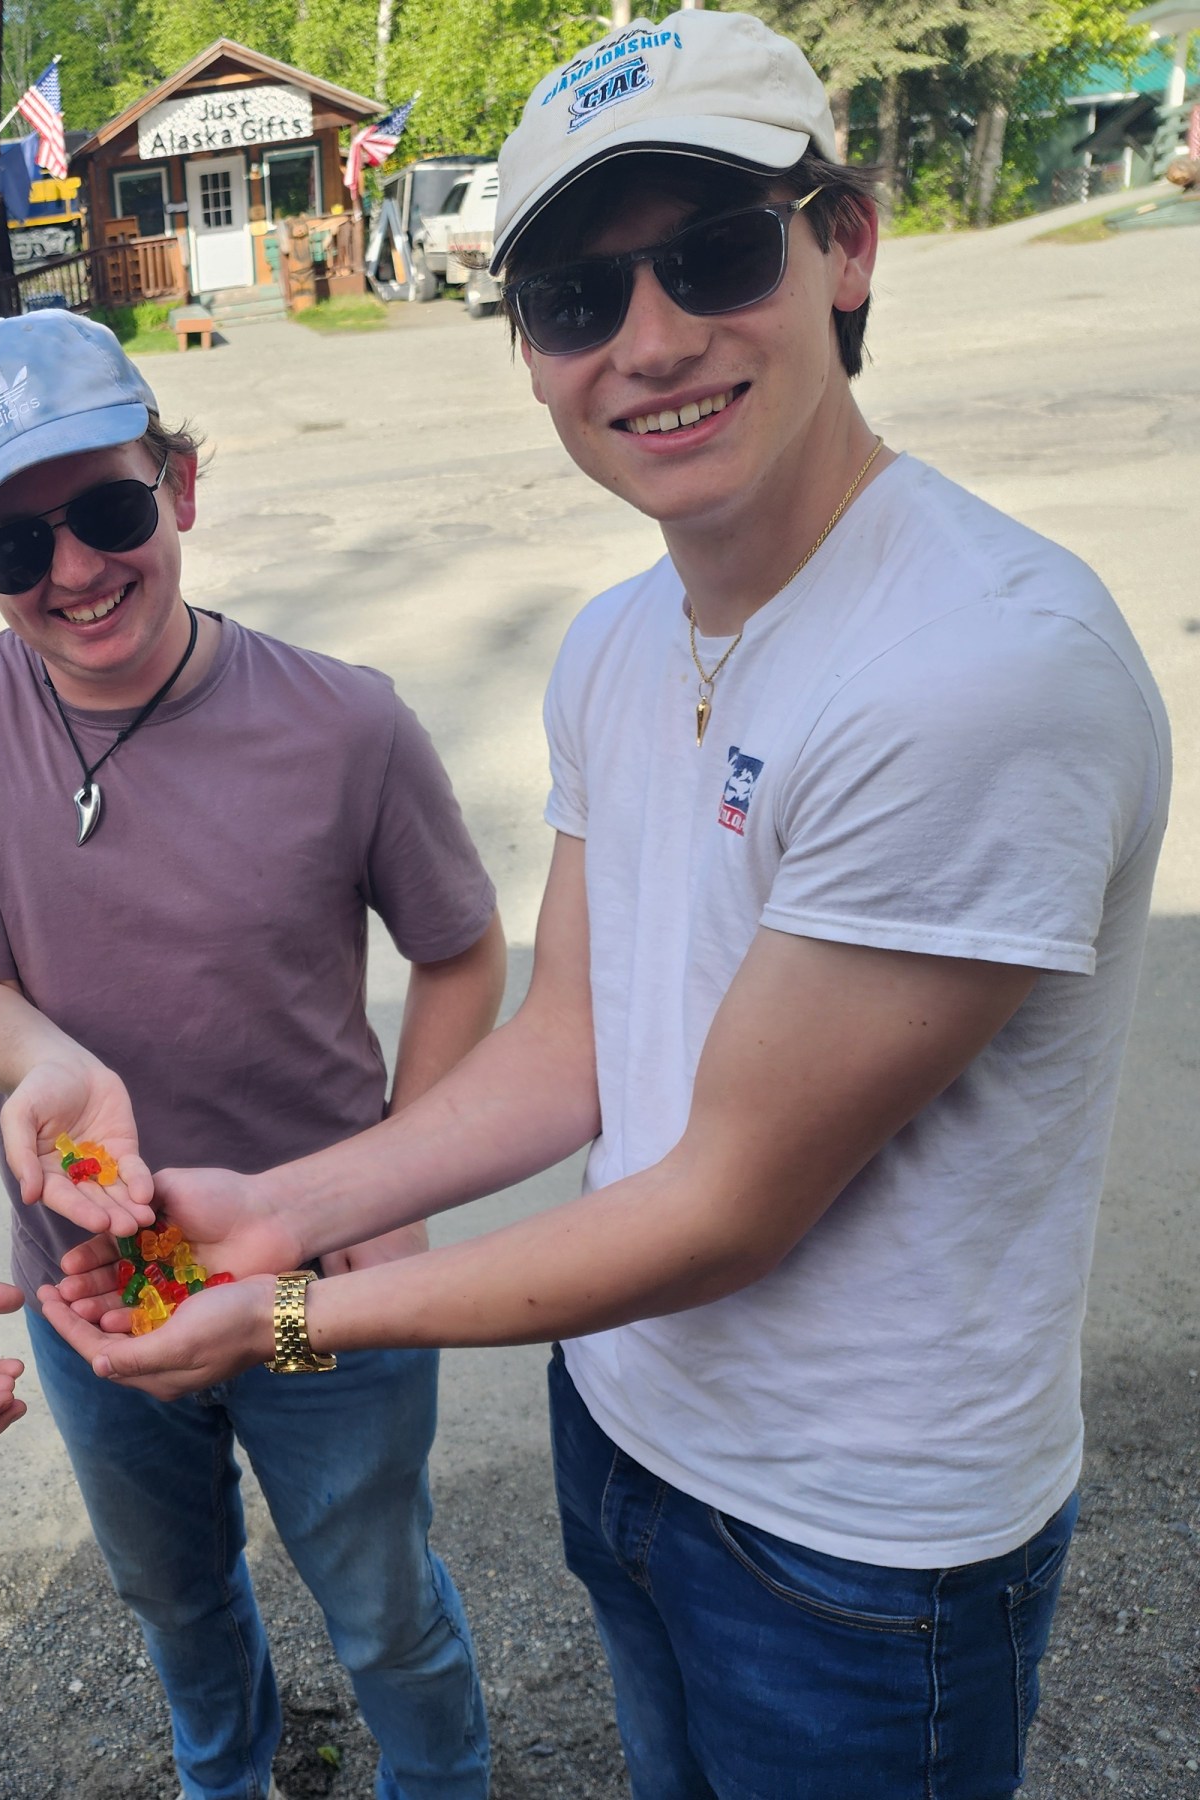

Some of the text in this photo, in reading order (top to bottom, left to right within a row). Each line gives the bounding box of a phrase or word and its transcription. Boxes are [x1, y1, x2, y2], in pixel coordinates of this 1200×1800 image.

[541, 31, 683, 106] CHAMPIONSHIPS
[200, 98, 250, 122] Just
[151, 115, 304, 155] Alaska Gifts
